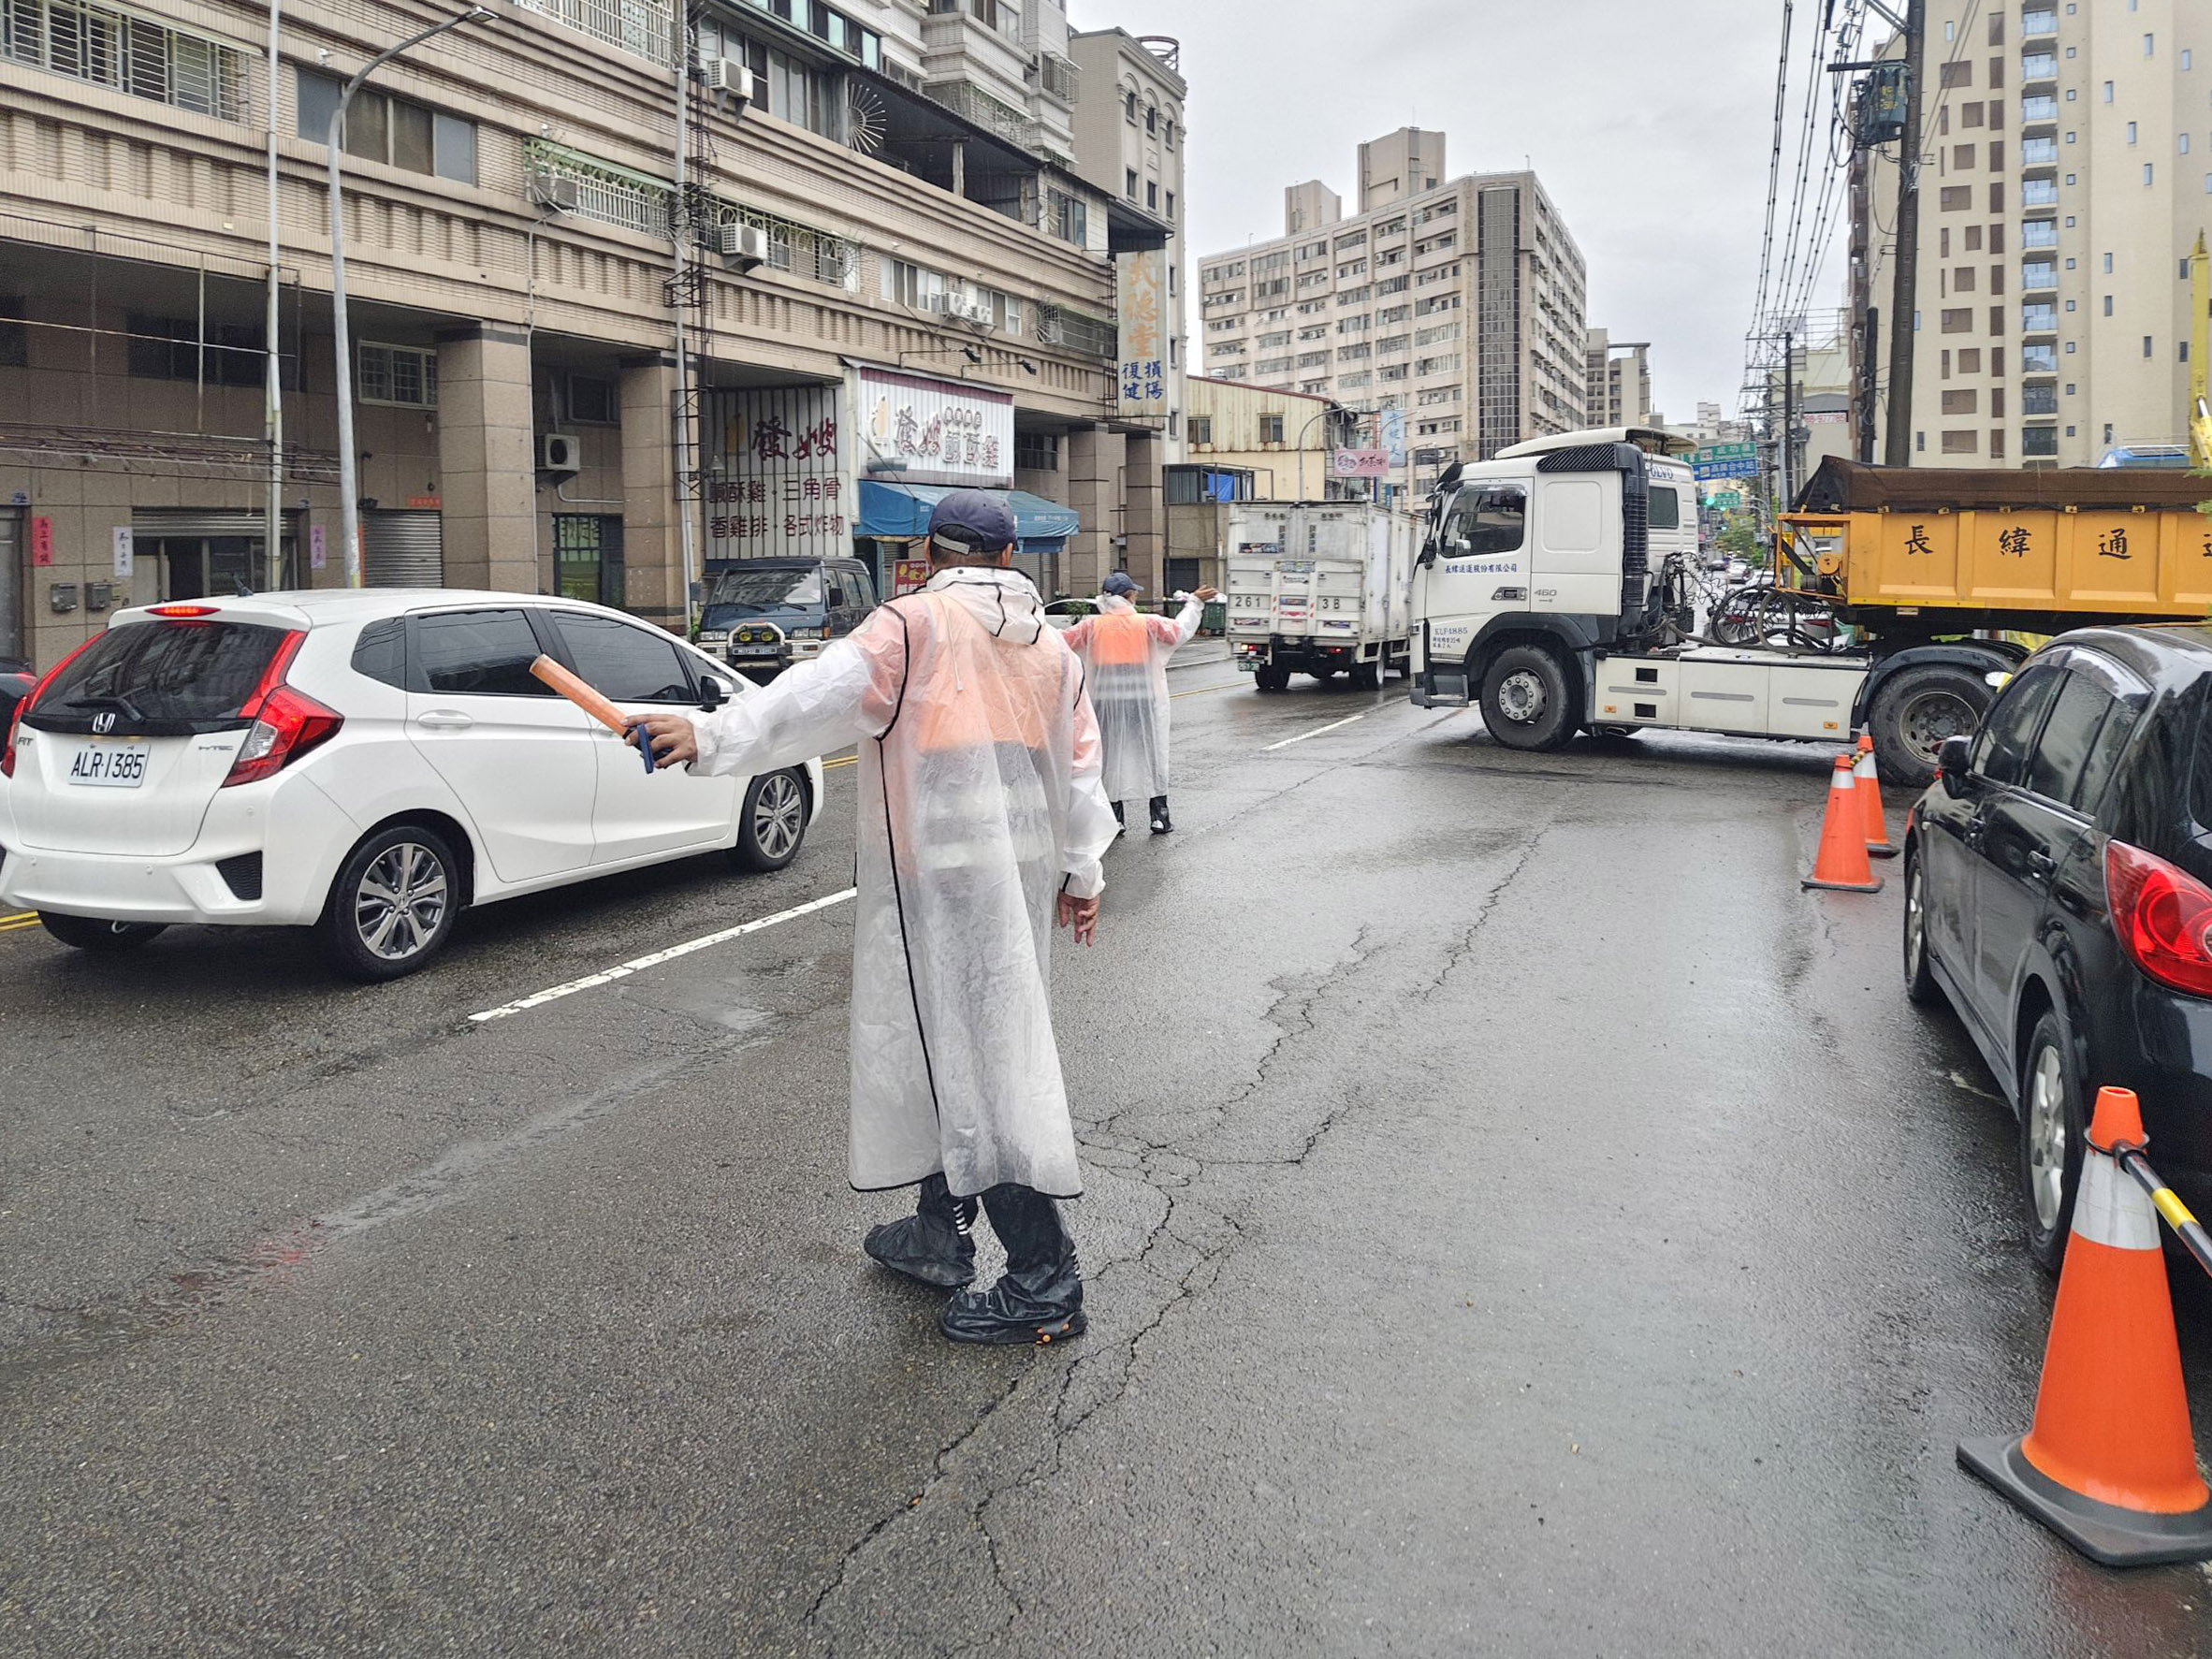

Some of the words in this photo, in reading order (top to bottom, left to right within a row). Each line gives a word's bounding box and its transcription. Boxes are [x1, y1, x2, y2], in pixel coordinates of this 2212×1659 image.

[1122, 361, 1143, 400] 復健
[1649, 464, 1674, 479] OLVO
[1535, 589, 1557, 597] 460
[1235, 596, 1260, 608] 261
